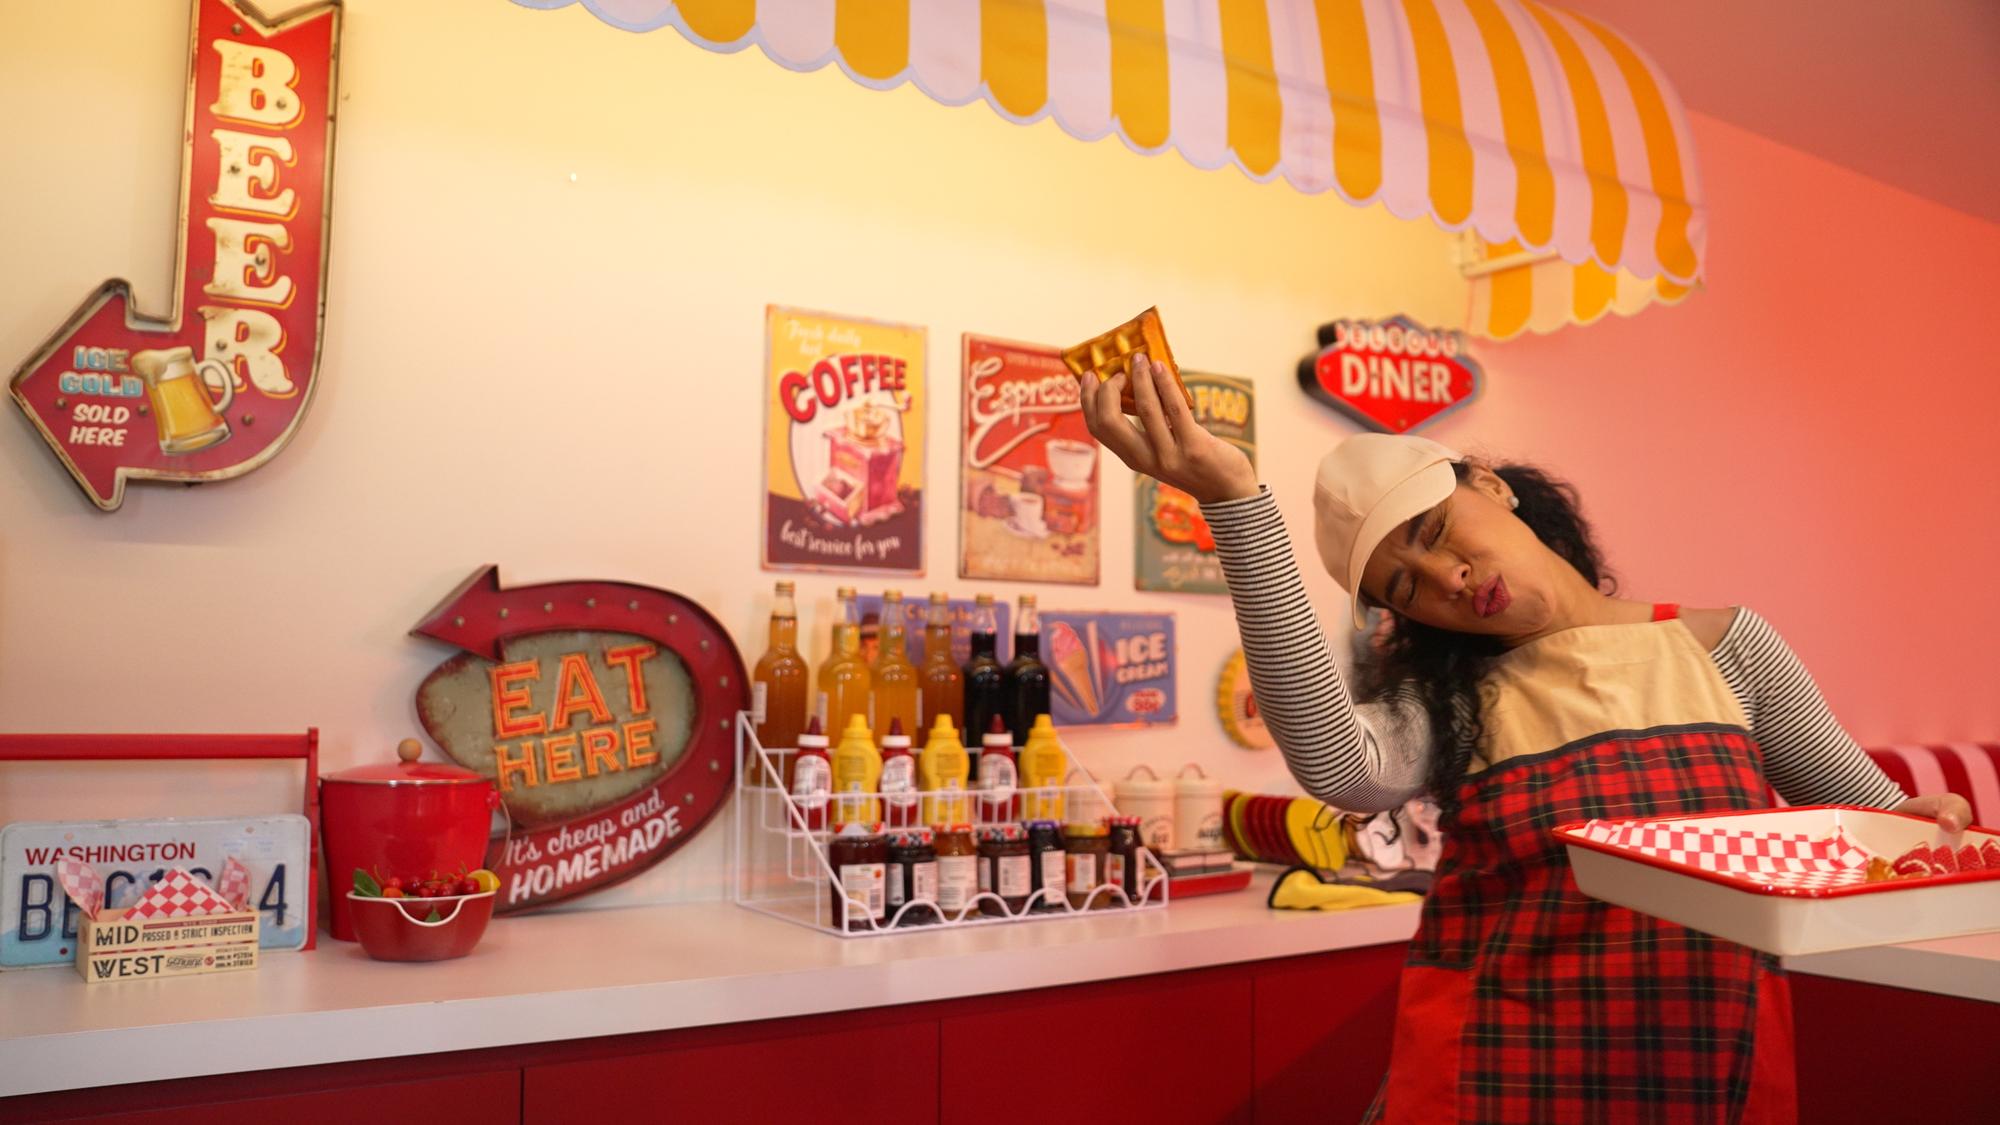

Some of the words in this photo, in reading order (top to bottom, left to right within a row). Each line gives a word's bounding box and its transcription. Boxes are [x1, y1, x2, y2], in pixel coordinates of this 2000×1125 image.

[199, 38, 304, 399] BEER
[73, 345, 130, 372] ICE
[58, 371, 144, 398] COLD
[779, 353, 908, 424] COFFEE
[1341, 352, 1453, 404] DINER
[72, 402, 131, 425] SOLD
[69, 425, 128, 447] HERE
[781, 519, 808, 550] best
[854, 533, 875, 560] for
[876, 536, 901, 560] you
[1115, 631, 1167, 666] ICE
[1116, 662, 1169, 685] CREAM
[489, 644, 657, 740] EAT
[495, 719, 661, 792] HERE
[505, 835, 542, 867] It's
[547, 825, 618, 856] cheap
[621, 788, 666, 828] and
[25, 842, 196, 866] WASHINGTON
[509, 805, 683, 905] HOMEMADE
[96, 925, 139, 947] MID
[182, 928, 207, 940] STRICT
[93, 955, 165, 979] WEST
